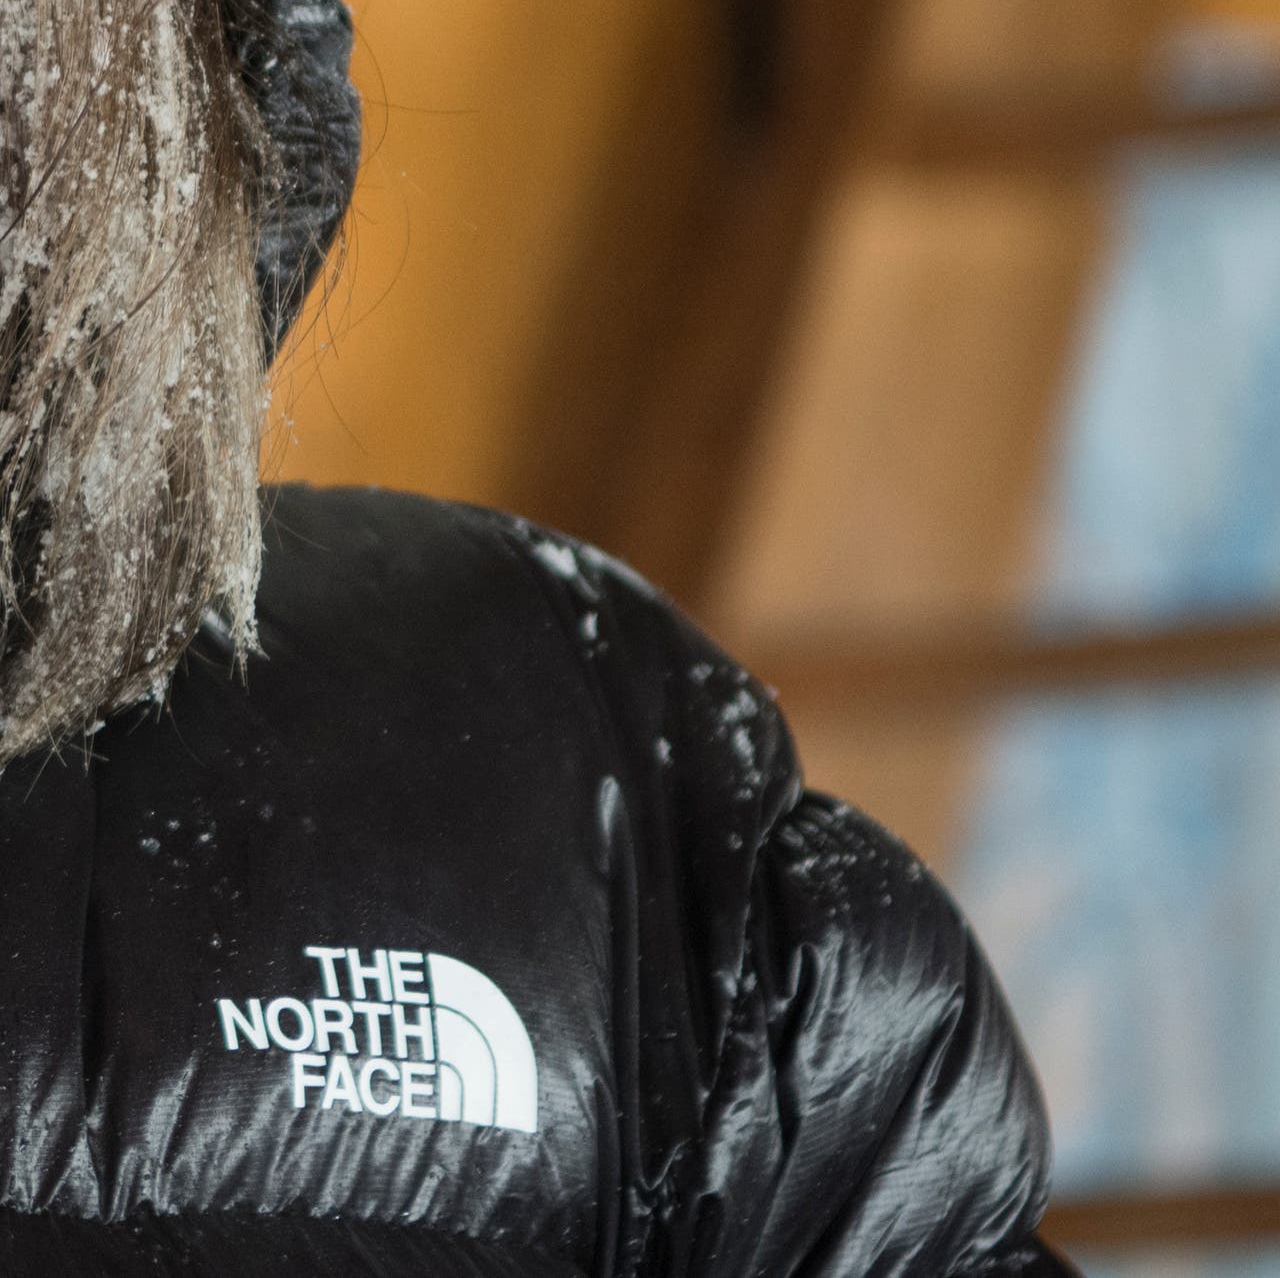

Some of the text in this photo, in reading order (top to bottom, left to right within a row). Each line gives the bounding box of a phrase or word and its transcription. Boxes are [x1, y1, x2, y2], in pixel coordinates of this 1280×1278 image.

[304, 945, 430, 1005] THE
[217, 996, 436, 1062] NORTH
[291, 1052, 437, 1119] FACE
